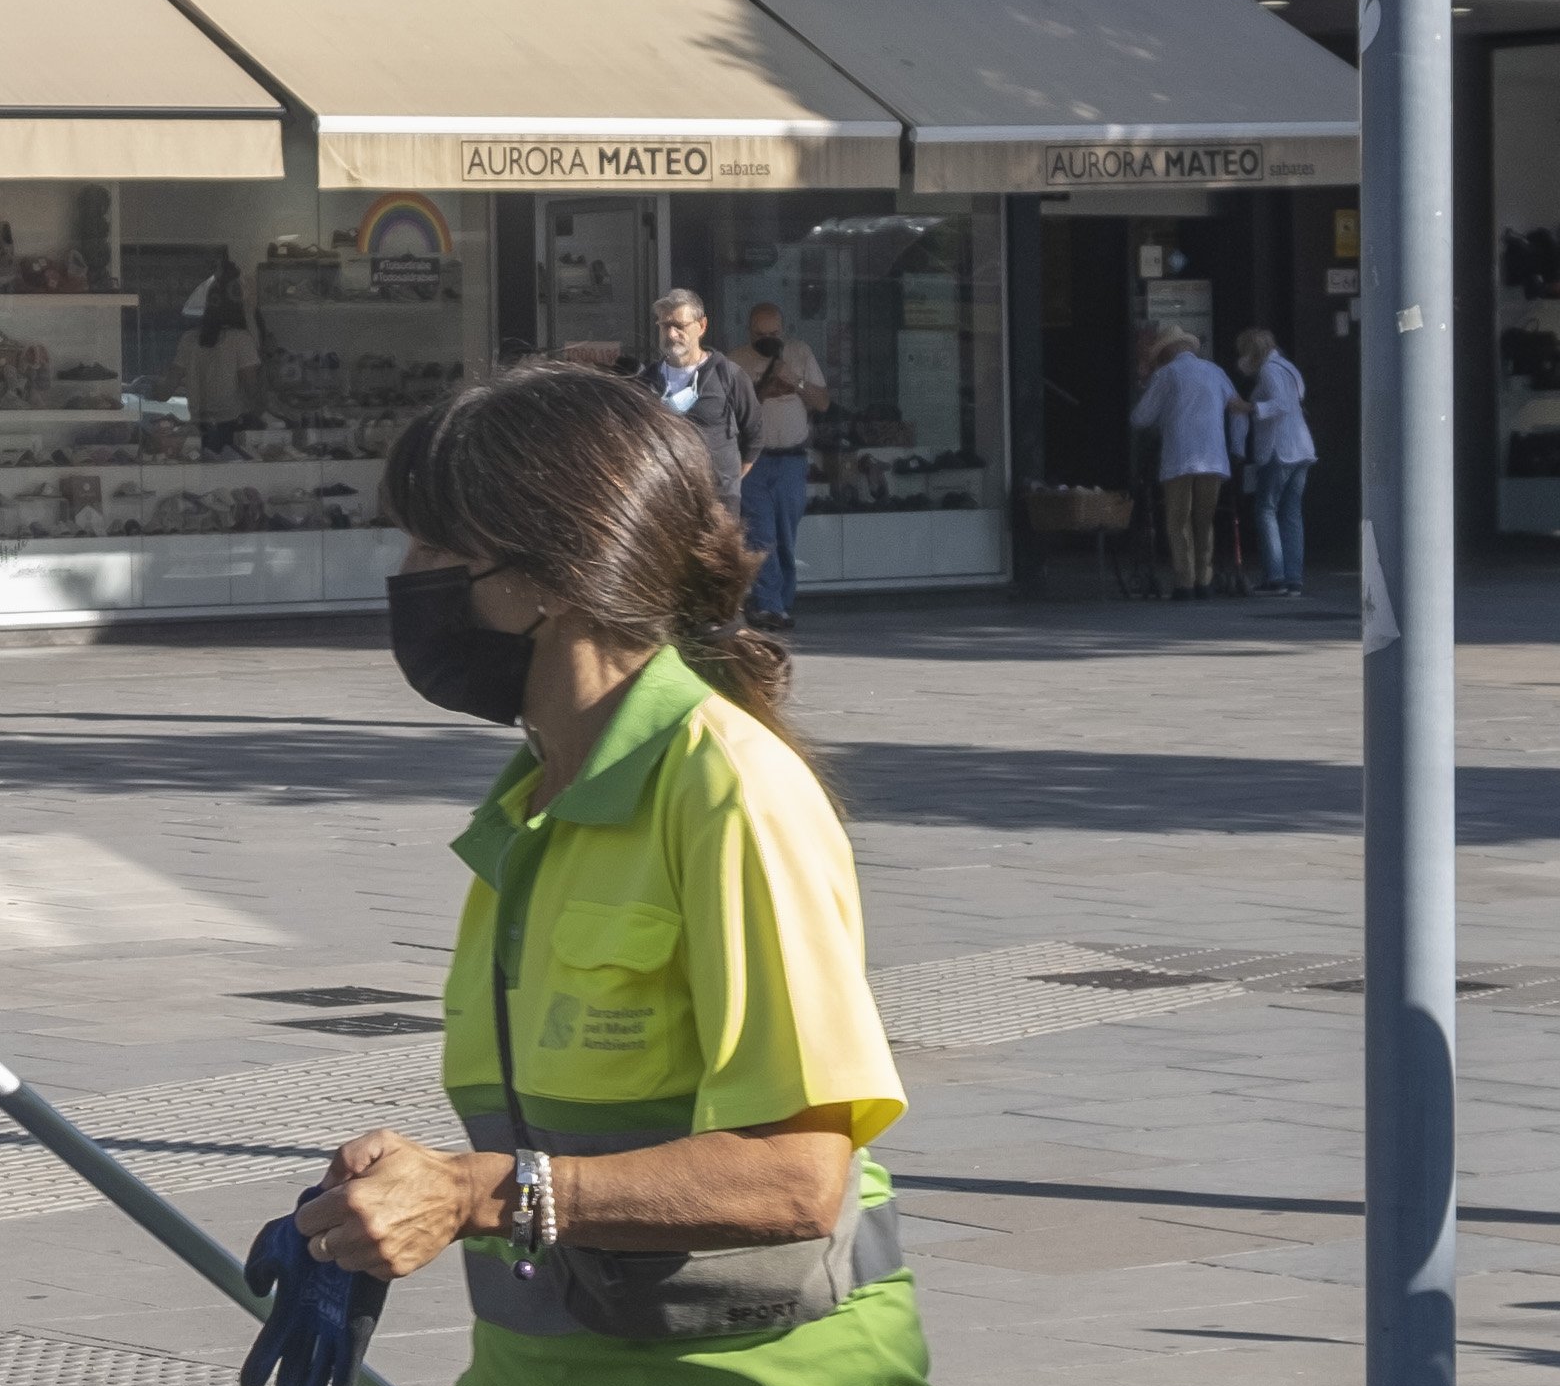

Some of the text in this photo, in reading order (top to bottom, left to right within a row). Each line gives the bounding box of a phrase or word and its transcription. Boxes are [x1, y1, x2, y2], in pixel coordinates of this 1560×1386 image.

[466, 146, 771, 176] AURORA MATEO sabates
[1050, 150, 1158, 179] AURORA
[1164, 148, 1260, 178] MATEO
[727, 1300, 799, 1322] SPORT
